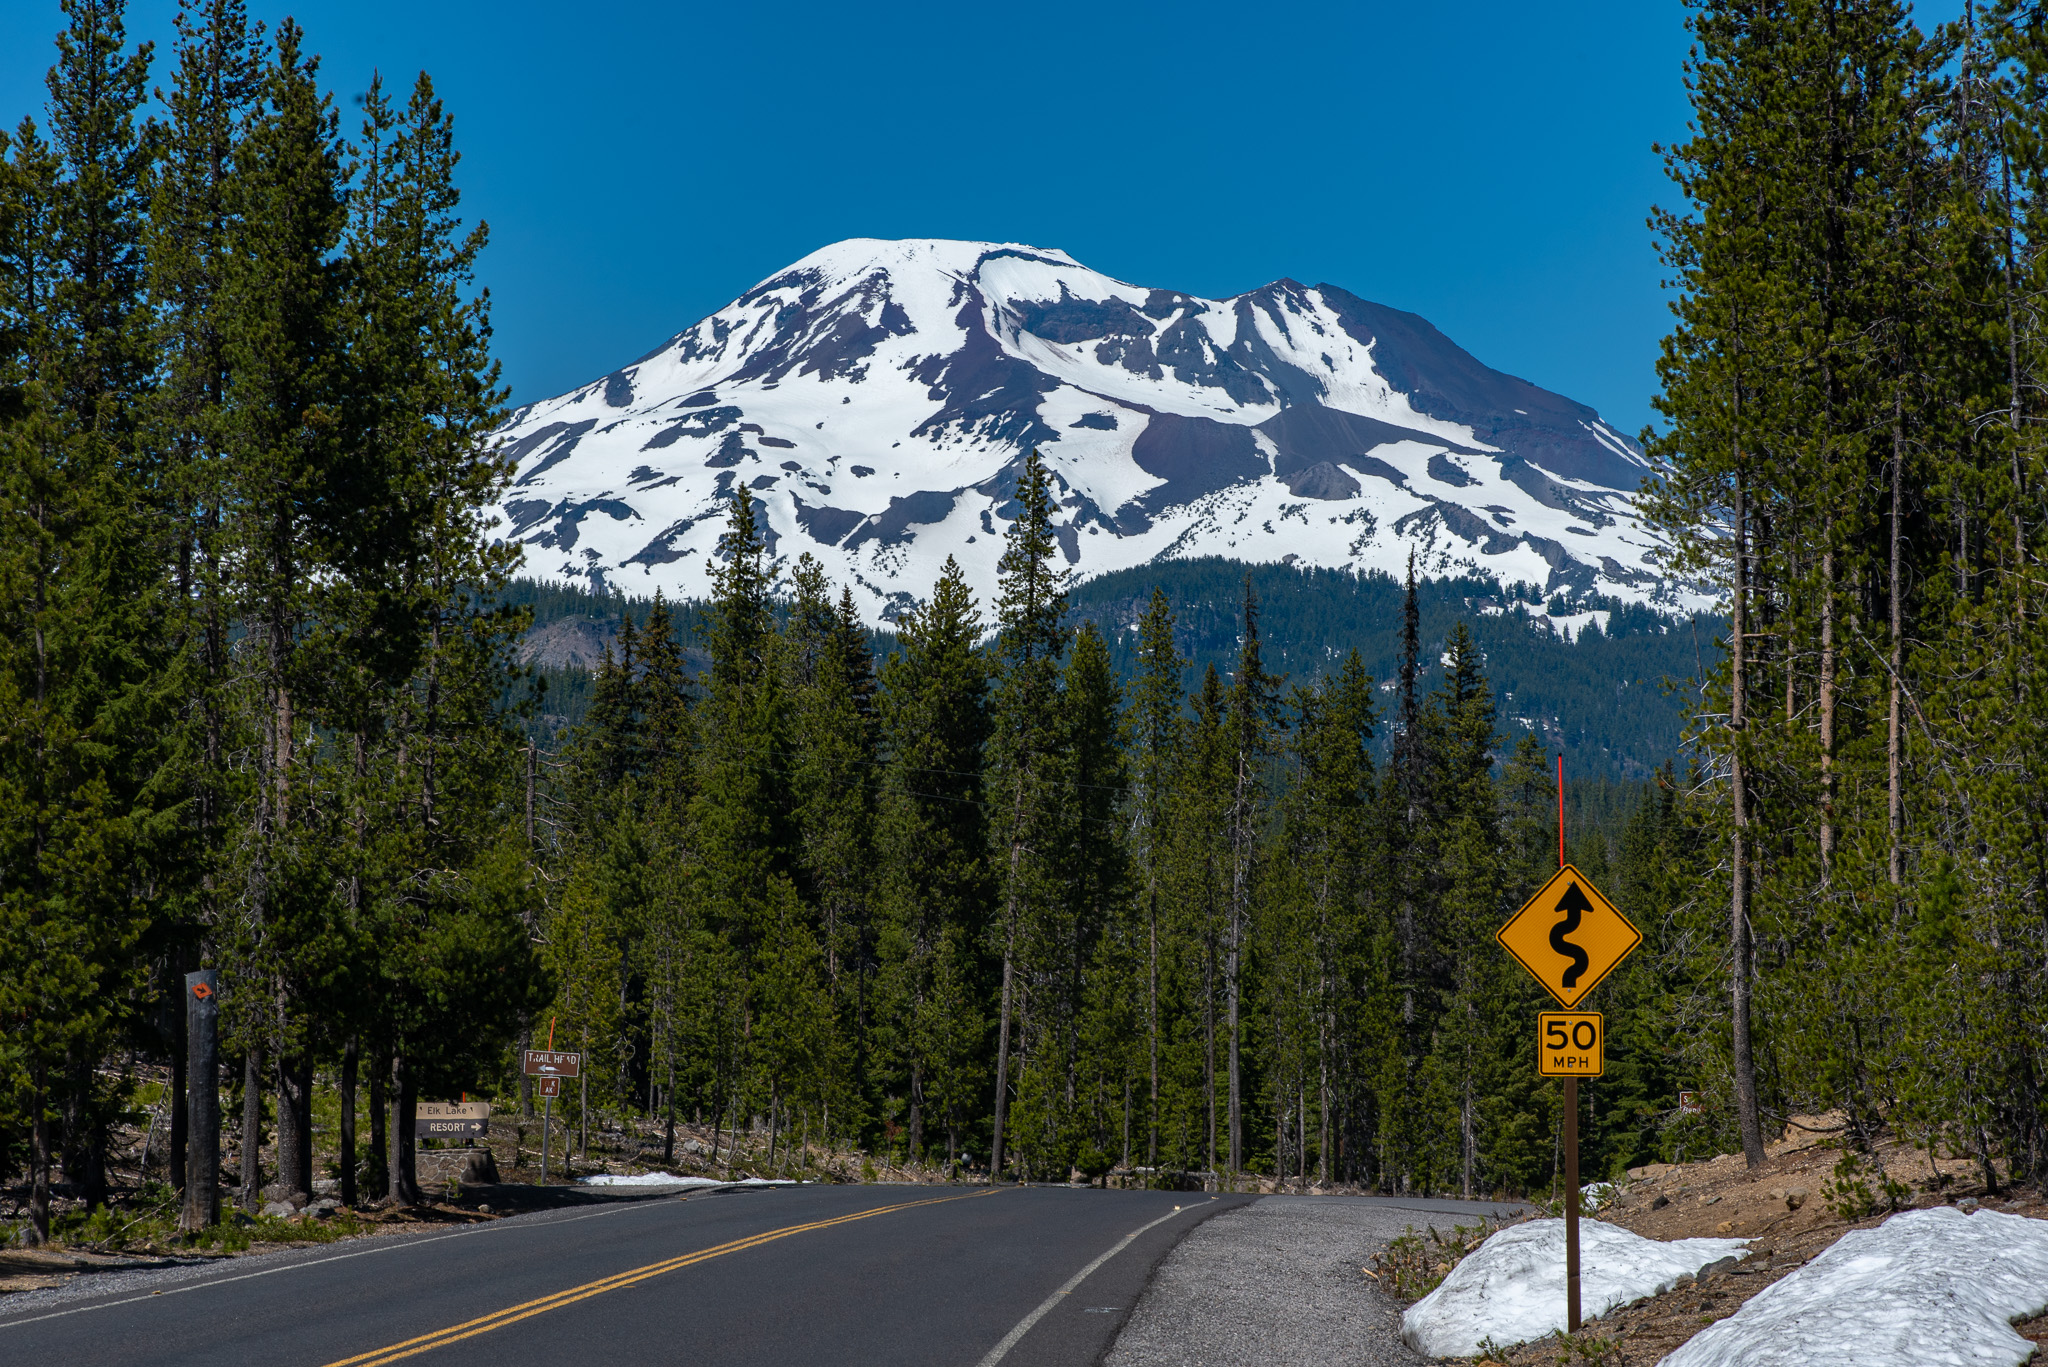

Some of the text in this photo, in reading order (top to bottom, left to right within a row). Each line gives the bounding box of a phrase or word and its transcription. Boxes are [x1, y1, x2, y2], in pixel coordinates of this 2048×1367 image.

[1546, 1021, 1596, 1050] 50
[1553, 1056, 1589, 1068] MPH
[427, 1106, 467, 1115] Elk Lake
[430, 1122, 465, 1132] RESORT
